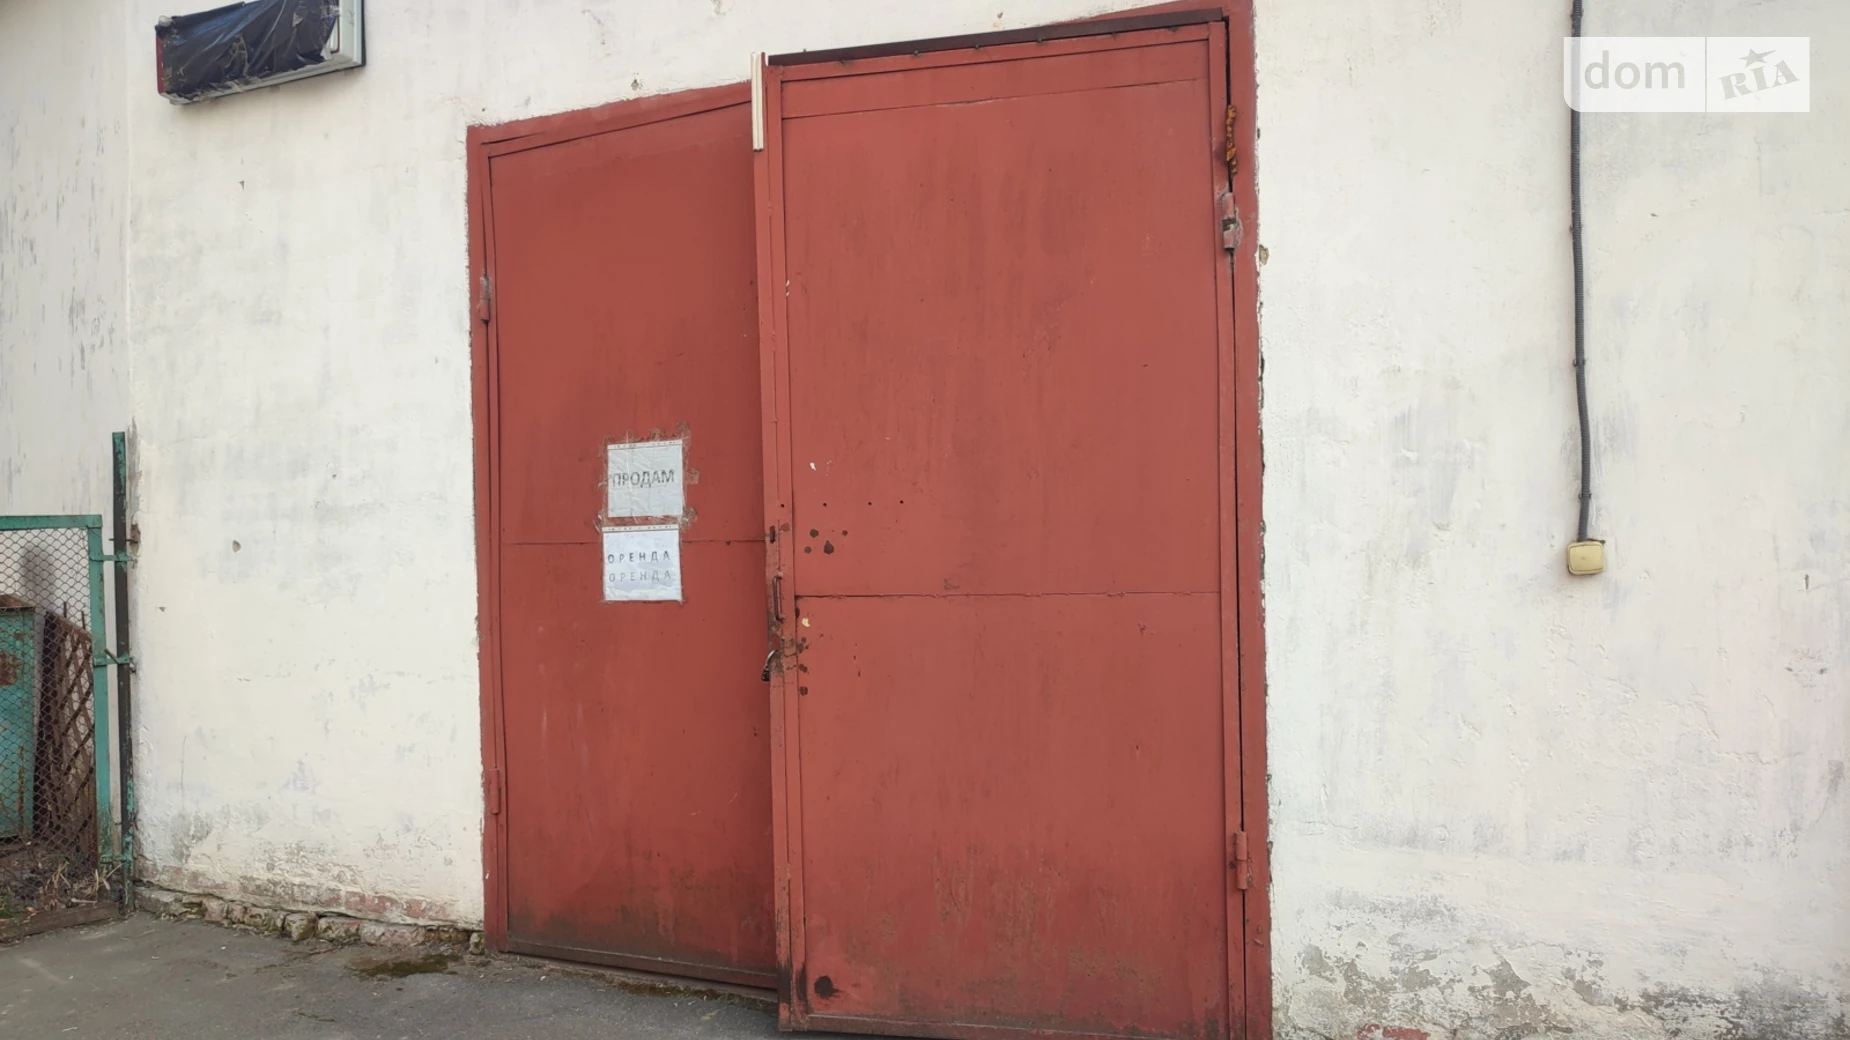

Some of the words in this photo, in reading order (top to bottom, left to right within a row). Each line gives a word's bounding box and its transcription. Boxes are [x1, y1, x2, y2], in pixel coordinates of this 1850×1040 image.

[612, 469, 675, 488] ПРОДАМ
[607, 550, 671, 564] ОРЕНДА
[609, 570, 672, 583] ОРЕНДА
